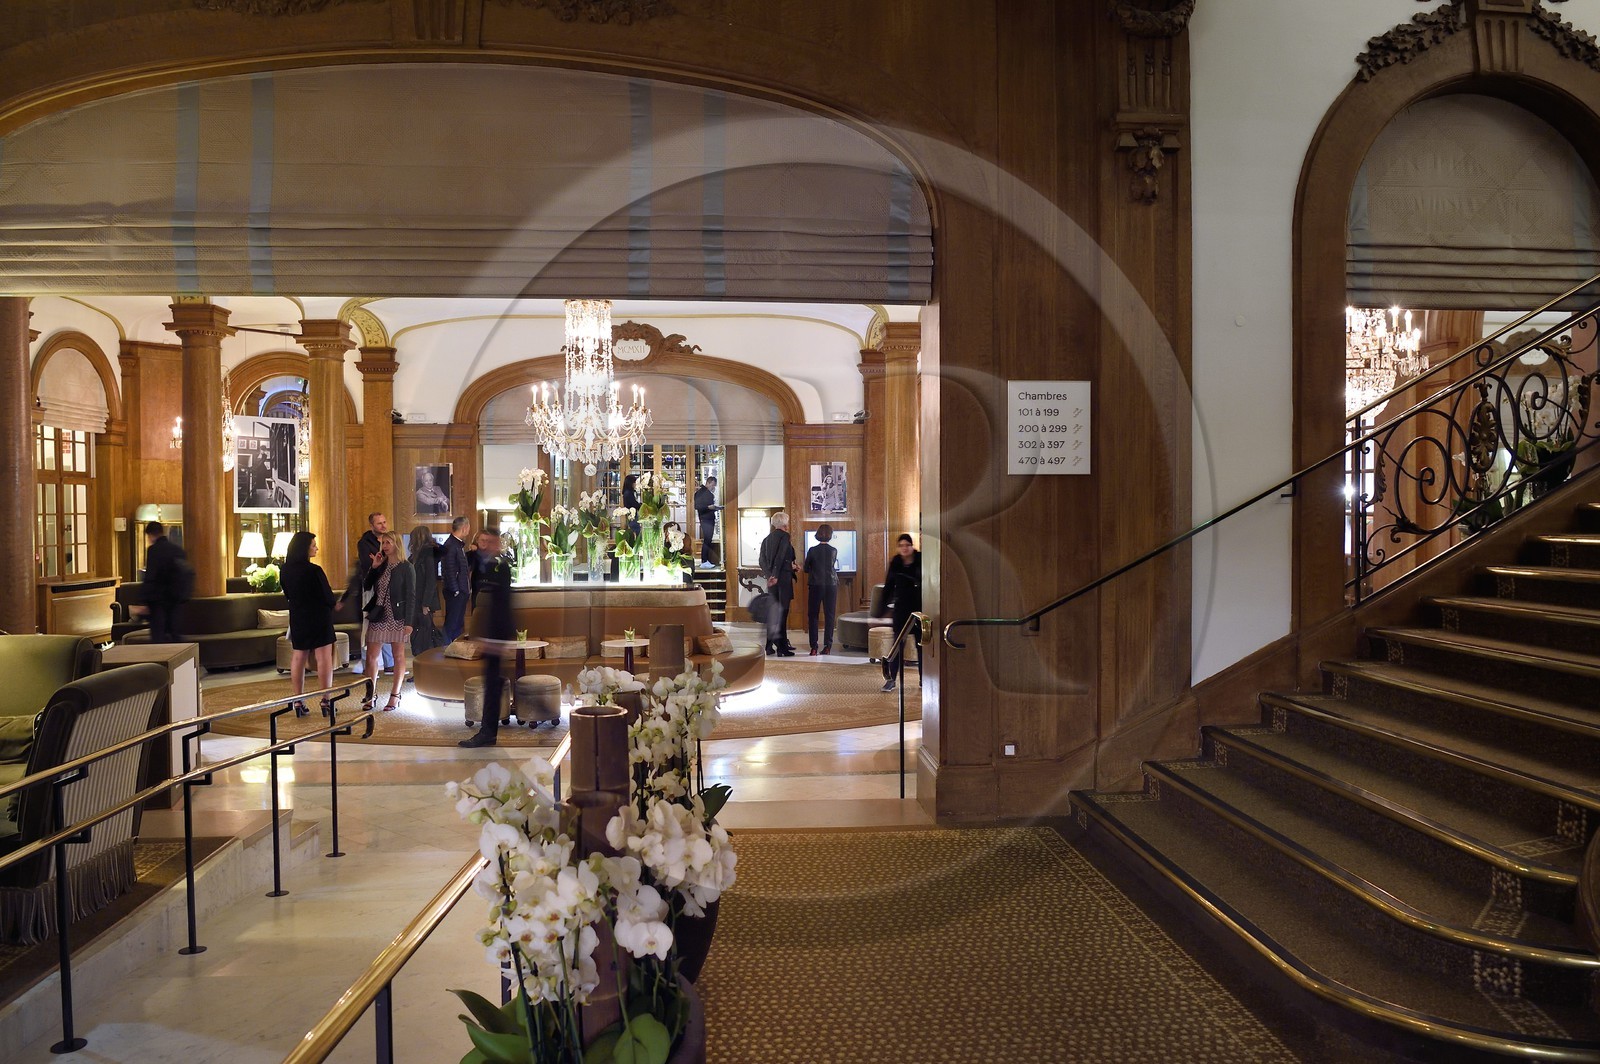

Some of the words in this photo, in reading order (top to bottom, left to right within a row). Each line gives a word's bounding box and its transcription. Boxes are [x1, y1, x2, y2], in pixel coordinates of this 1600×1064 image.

[1018, 392, 1067, 400] Chambres
[1018, 408, 1033, 416] 101
[1035, 408, 1041, 416] à
[1043, 408, 1059, 416] 199
[1018, 425, 1039, 433] 200
[1041, 424, 1047, 433] à
[1049, 425, 1067, 433] 299
[1018, 441, 1037, 449] 302
[1040, 440, 1045, 449] à
[1047, 441, 1065, 449] 397
[1018, 457, 1037, 465] 470
[1039, 456, 1045, 465] à
[1047, 457, 1066, 465] 497
